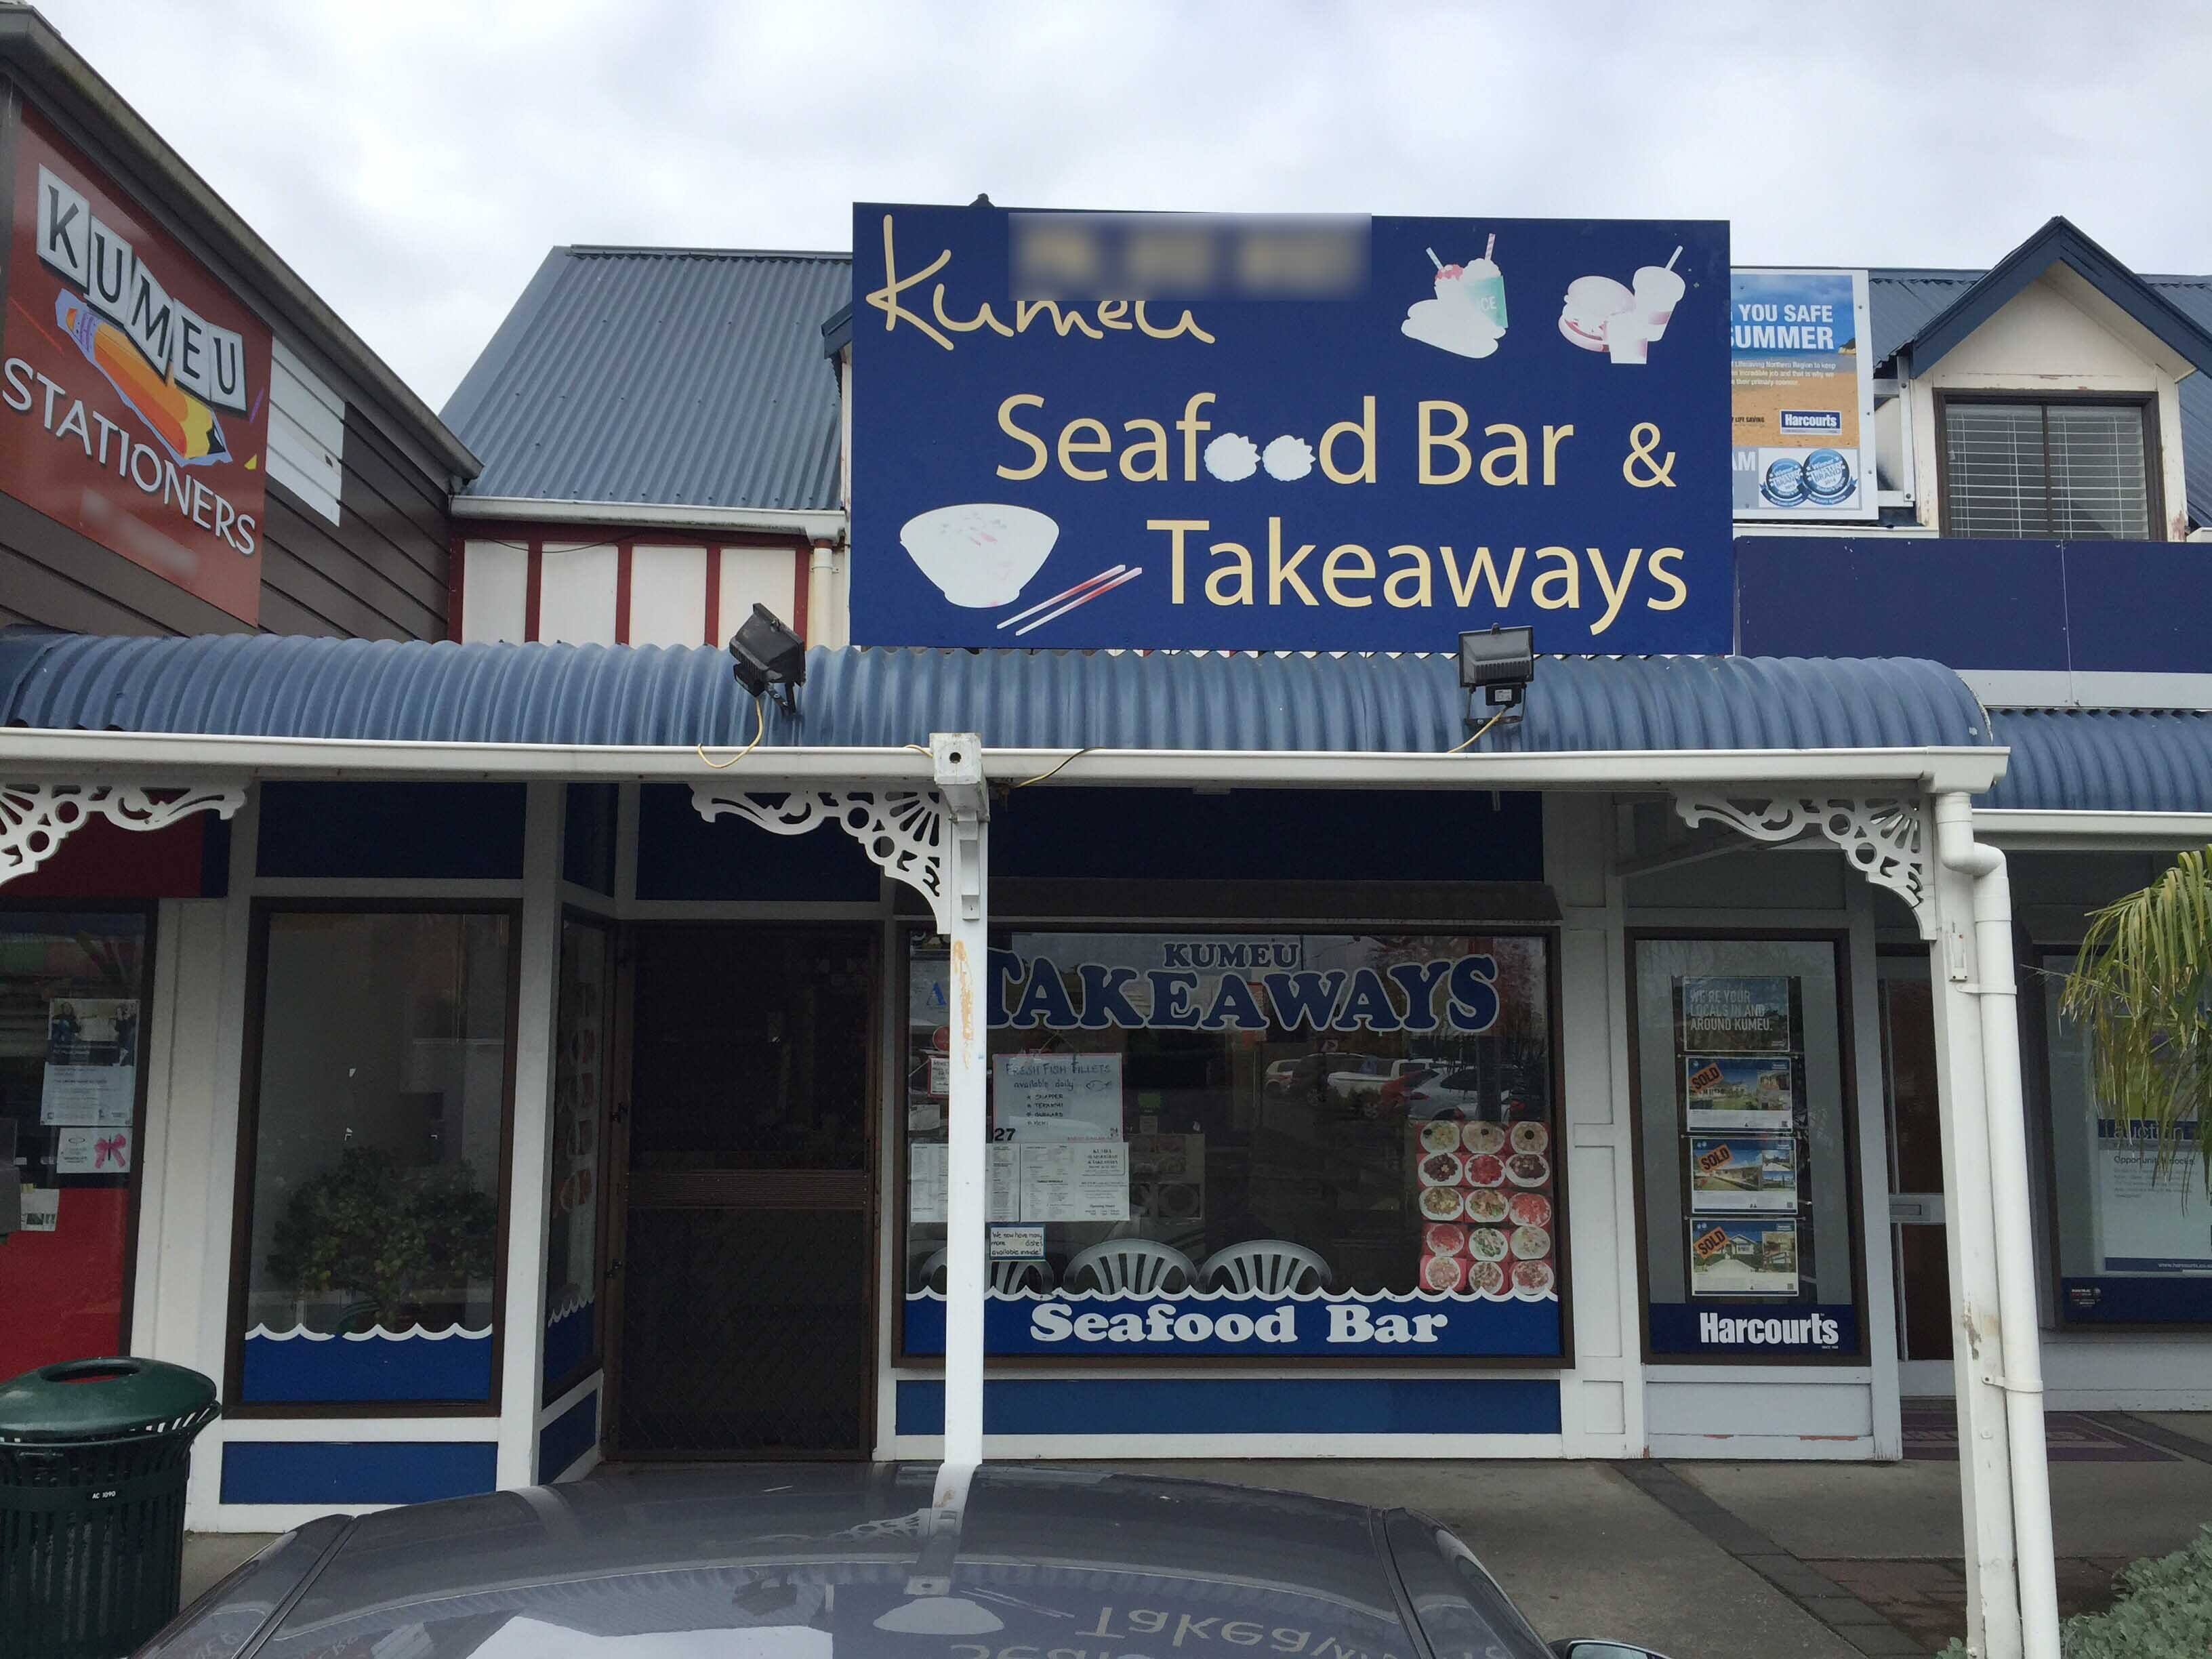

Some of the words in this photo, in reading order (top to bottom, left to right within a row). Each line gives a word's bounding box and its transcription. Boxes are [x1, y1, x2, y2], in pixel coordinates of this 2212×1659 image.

[46, 184, 237, 395] KUMEU
[865, 213, 1216, 351] Kumeu
[1738, 304, 1778, 322] YOU
[1784, 304, 1833, 323] SAFE
[1784, 414, 1837, 427] Harcourts
[1418, 400, 1574, 487] Bar
[1622, 422, 1677, 488] &
[1, 357, 256, 556] STATIONERS
[1147, 516, 1687, 636] Takeaways
[1163, 943, 1300, 968] KUMEU
[987, 951, 1498, 1030] TAKEAWAYS
[1690, 990, 1721, 1003] WE'RE
[1724, 990, 1750, 1003] YOUR
[1691, 1004, 1729, 1017] LOCALS
[1745, 1004, 1765, 1017] AND
[1691, 1018, 1732, 1031] AROUND
[1735, 1018, 1773, 1031] KUMEU.
[1044, 1062, 1067, 1075] FISH
[1071, 1061, 1111, 1074] FILLETS
[1692, 1067, 1720, 1089] SOLD
[1055, 1078, 1073, 1091] daily
[1700, 1148, 1730, 1170] SOLD
[992, 1231, 1002, 1239] We
[1015, 1231, 1028, 1239] have
[1698, 1230, 1725, 1255] SOLD
[1029, 1303, 1298, 1343] Seafood
[1326, 1304, 1448, 1343] Bar
[1700, 1312, 1839, 1345] Harcourts
